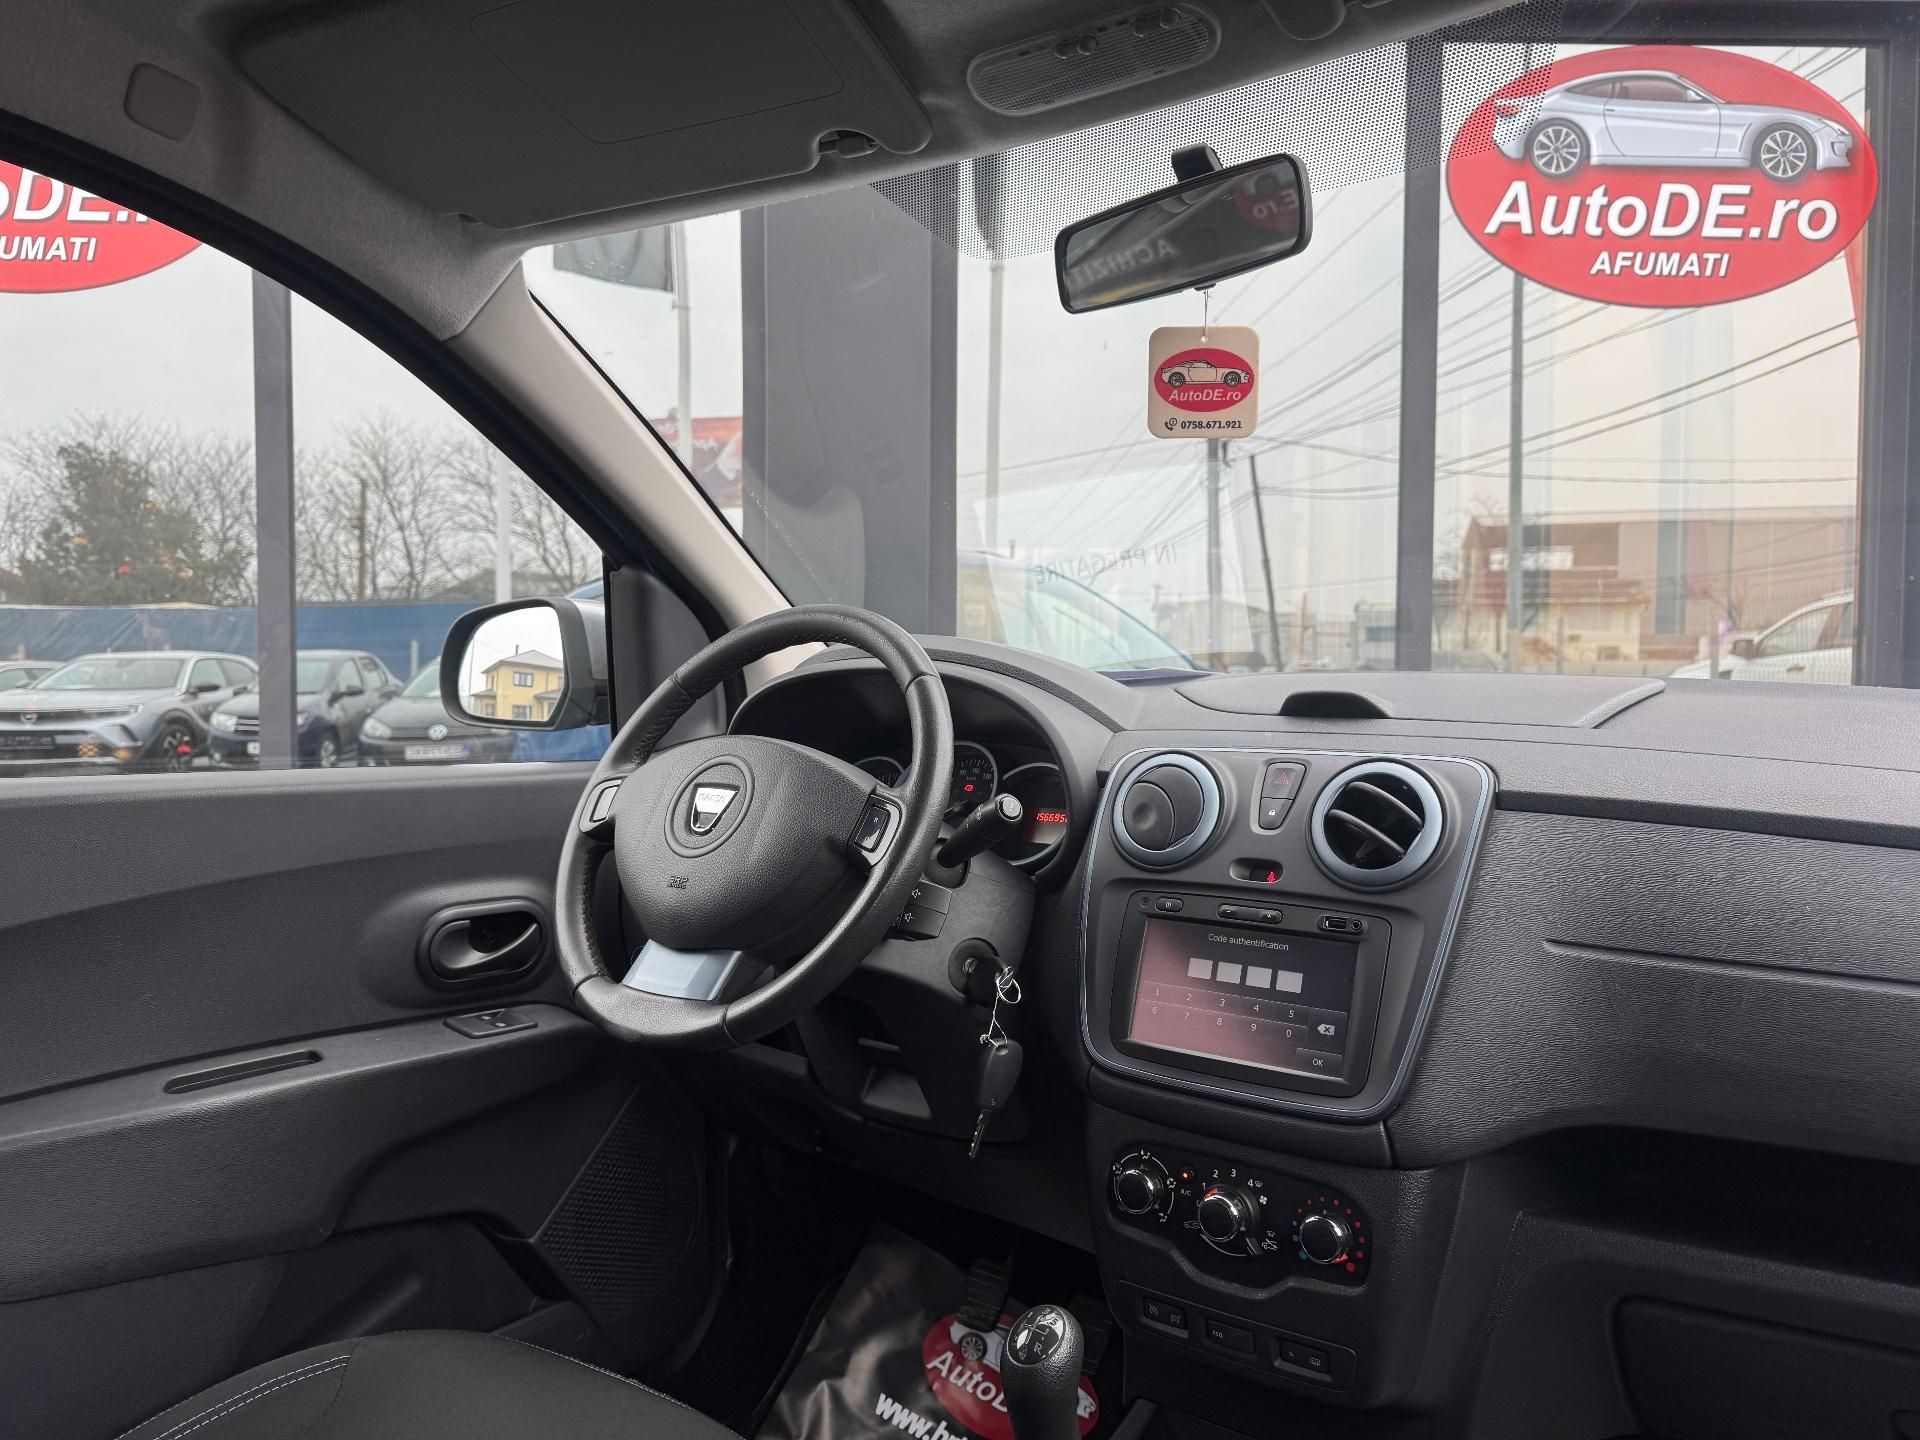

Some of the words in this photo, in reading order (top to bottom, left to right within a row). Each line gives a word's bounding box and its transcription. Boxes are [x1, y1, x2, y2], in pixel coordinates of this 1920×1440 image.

[1484, 180, 1838, 240] AutoDE.ro
[1590, 251, 1730, 277] AFUMATI
[1168, 389, 1242, 401] AutoDE.ro
[1180, 420, 1242, 430] 0758.671.921
[1208, 933, 1228, 943] Code
[1229, 936, 1289, 951] authentification
[1312, 1058, 1324, 1067] OK
[1212, 1169, 1219, 1178] 2
[1230, 1168, 1237, 1178] 3
[1247, 1178, 1254, 1188] 4
